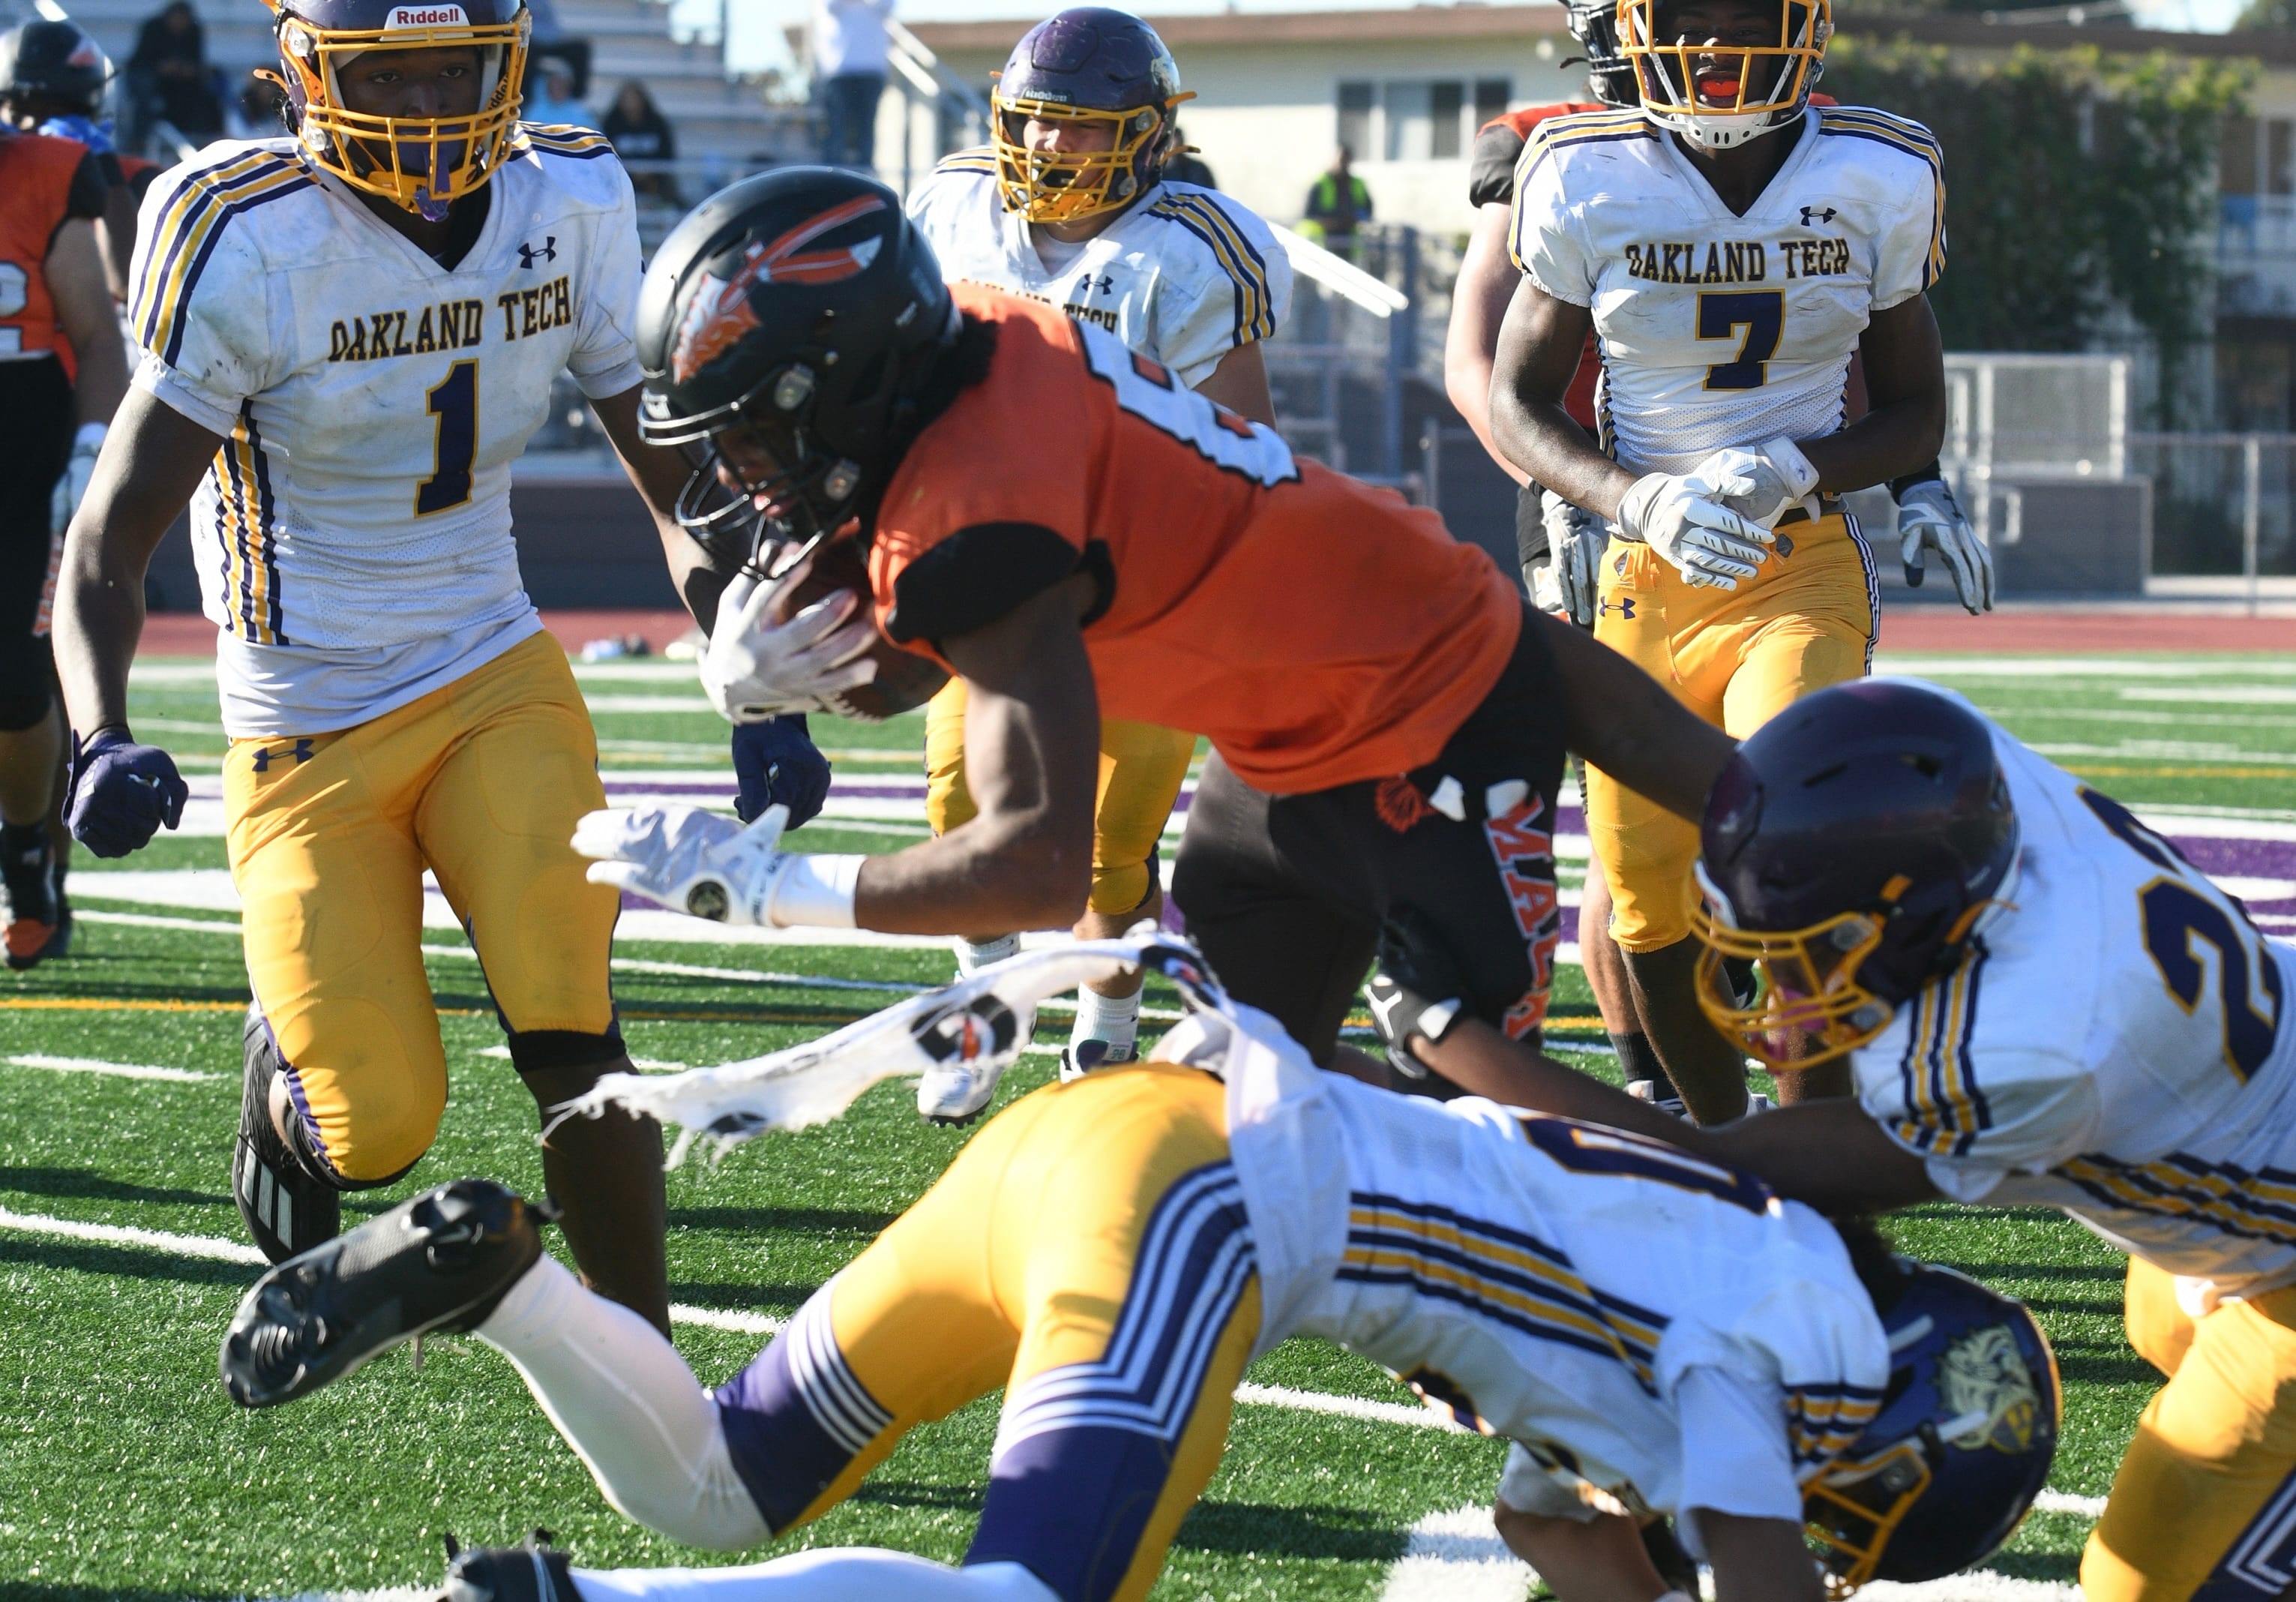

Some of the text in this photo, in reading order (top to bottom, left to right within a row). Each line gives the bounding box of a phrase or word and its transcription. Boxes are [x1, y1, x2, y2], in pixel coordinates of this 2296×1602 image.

[397, 9, 460, 25] Riddell
[1624, 237, 1851, 285] OAKLAND TECH
[328, 274, 572, 363] OAKLAND TECH
[1695, 288, 1787, 392] 7
[413, 357, 480, 520] 1
